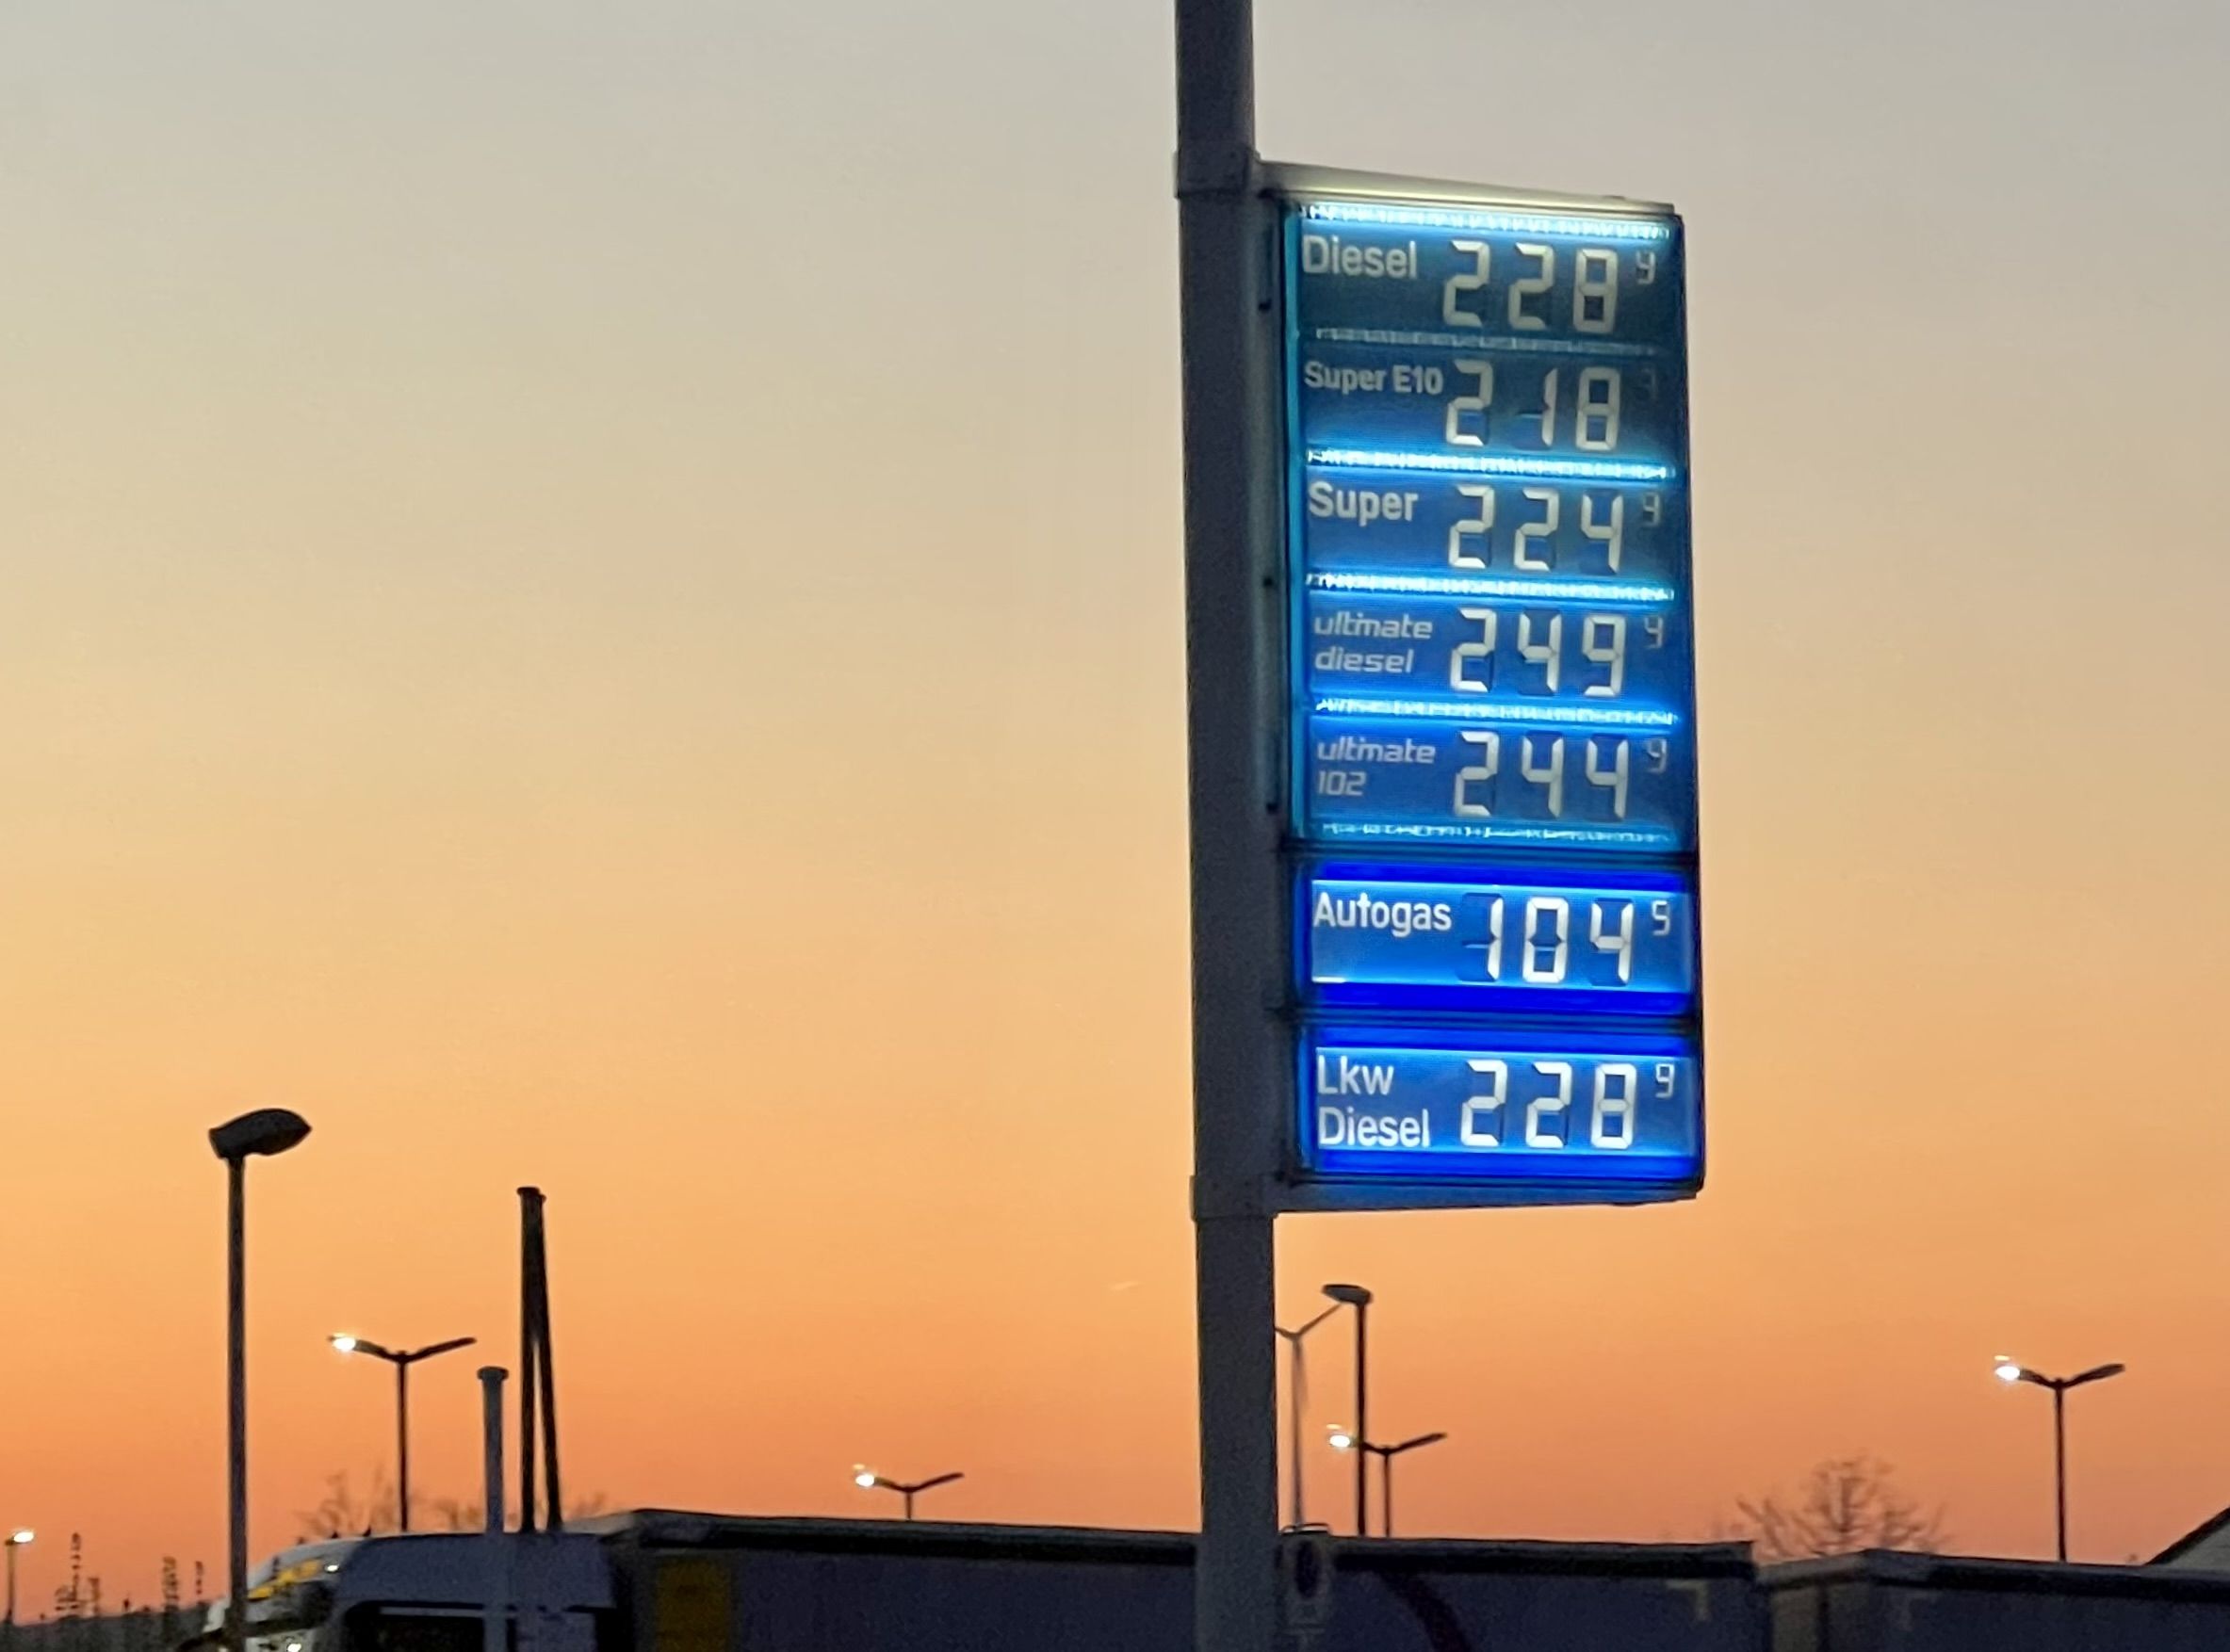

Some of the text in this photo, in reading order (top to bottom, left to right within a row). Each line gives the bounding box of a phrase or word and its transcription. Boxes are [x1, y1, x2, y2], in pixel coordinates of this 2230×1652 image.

[1303, 235, 1416, 279] Diesel
[1443, 240, 1619, 333] 228
[1305, 361, 1387, 395] Super
[1393, 364, 1443, 395] E10
[1446, 360, 1620, 451] 218
[1308, 481, 1418, 526] Super
[1448, 484, 1623, 574] 224
[1314, 612, 1432, 640] ultimate
[1315, 649, 1413, 674] diesel
[1450, 607, 1627, 697] 249
[1317, 737, 1436, 764] ultimate
[1318, 770, 1366, 797] 102
[1454, 730, 1629, 818] 244
[1313, 891, 1452, 938] Autogas
[1486, 896, 1634, 983] 104
[1318, 1056, 1393, 1095] Lkw
[1460, 1060, 1637, 1149] 228
[1318, 1107, 1430, 1148] Diesel
